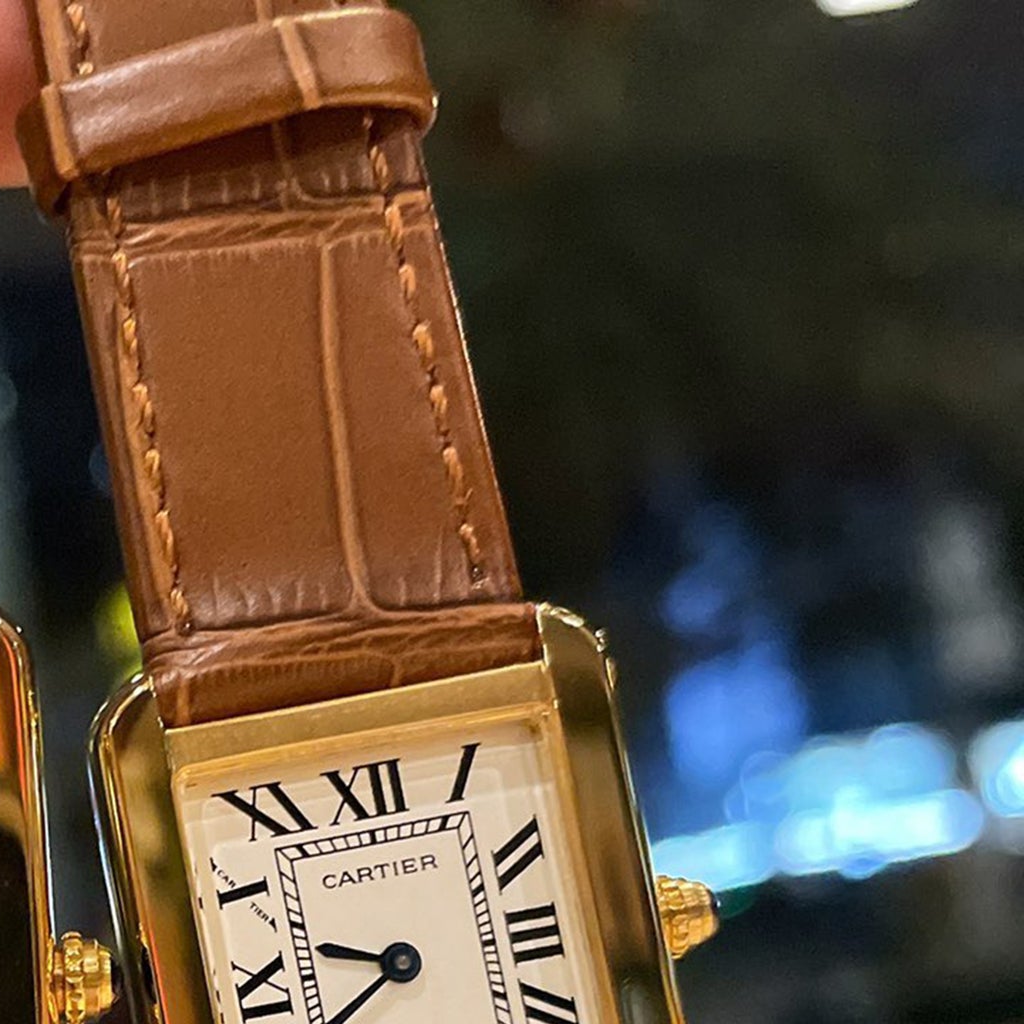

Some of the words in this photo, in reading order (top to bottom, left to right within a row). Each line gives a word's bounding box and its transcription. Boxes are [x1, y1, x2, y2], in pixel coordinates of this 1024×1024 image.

[212, 782, 317, 841] XI
[320, 758, 409, 826] XII
[322, 853, 439, 890] CARTIER
[505, 902, 564, 967] III
